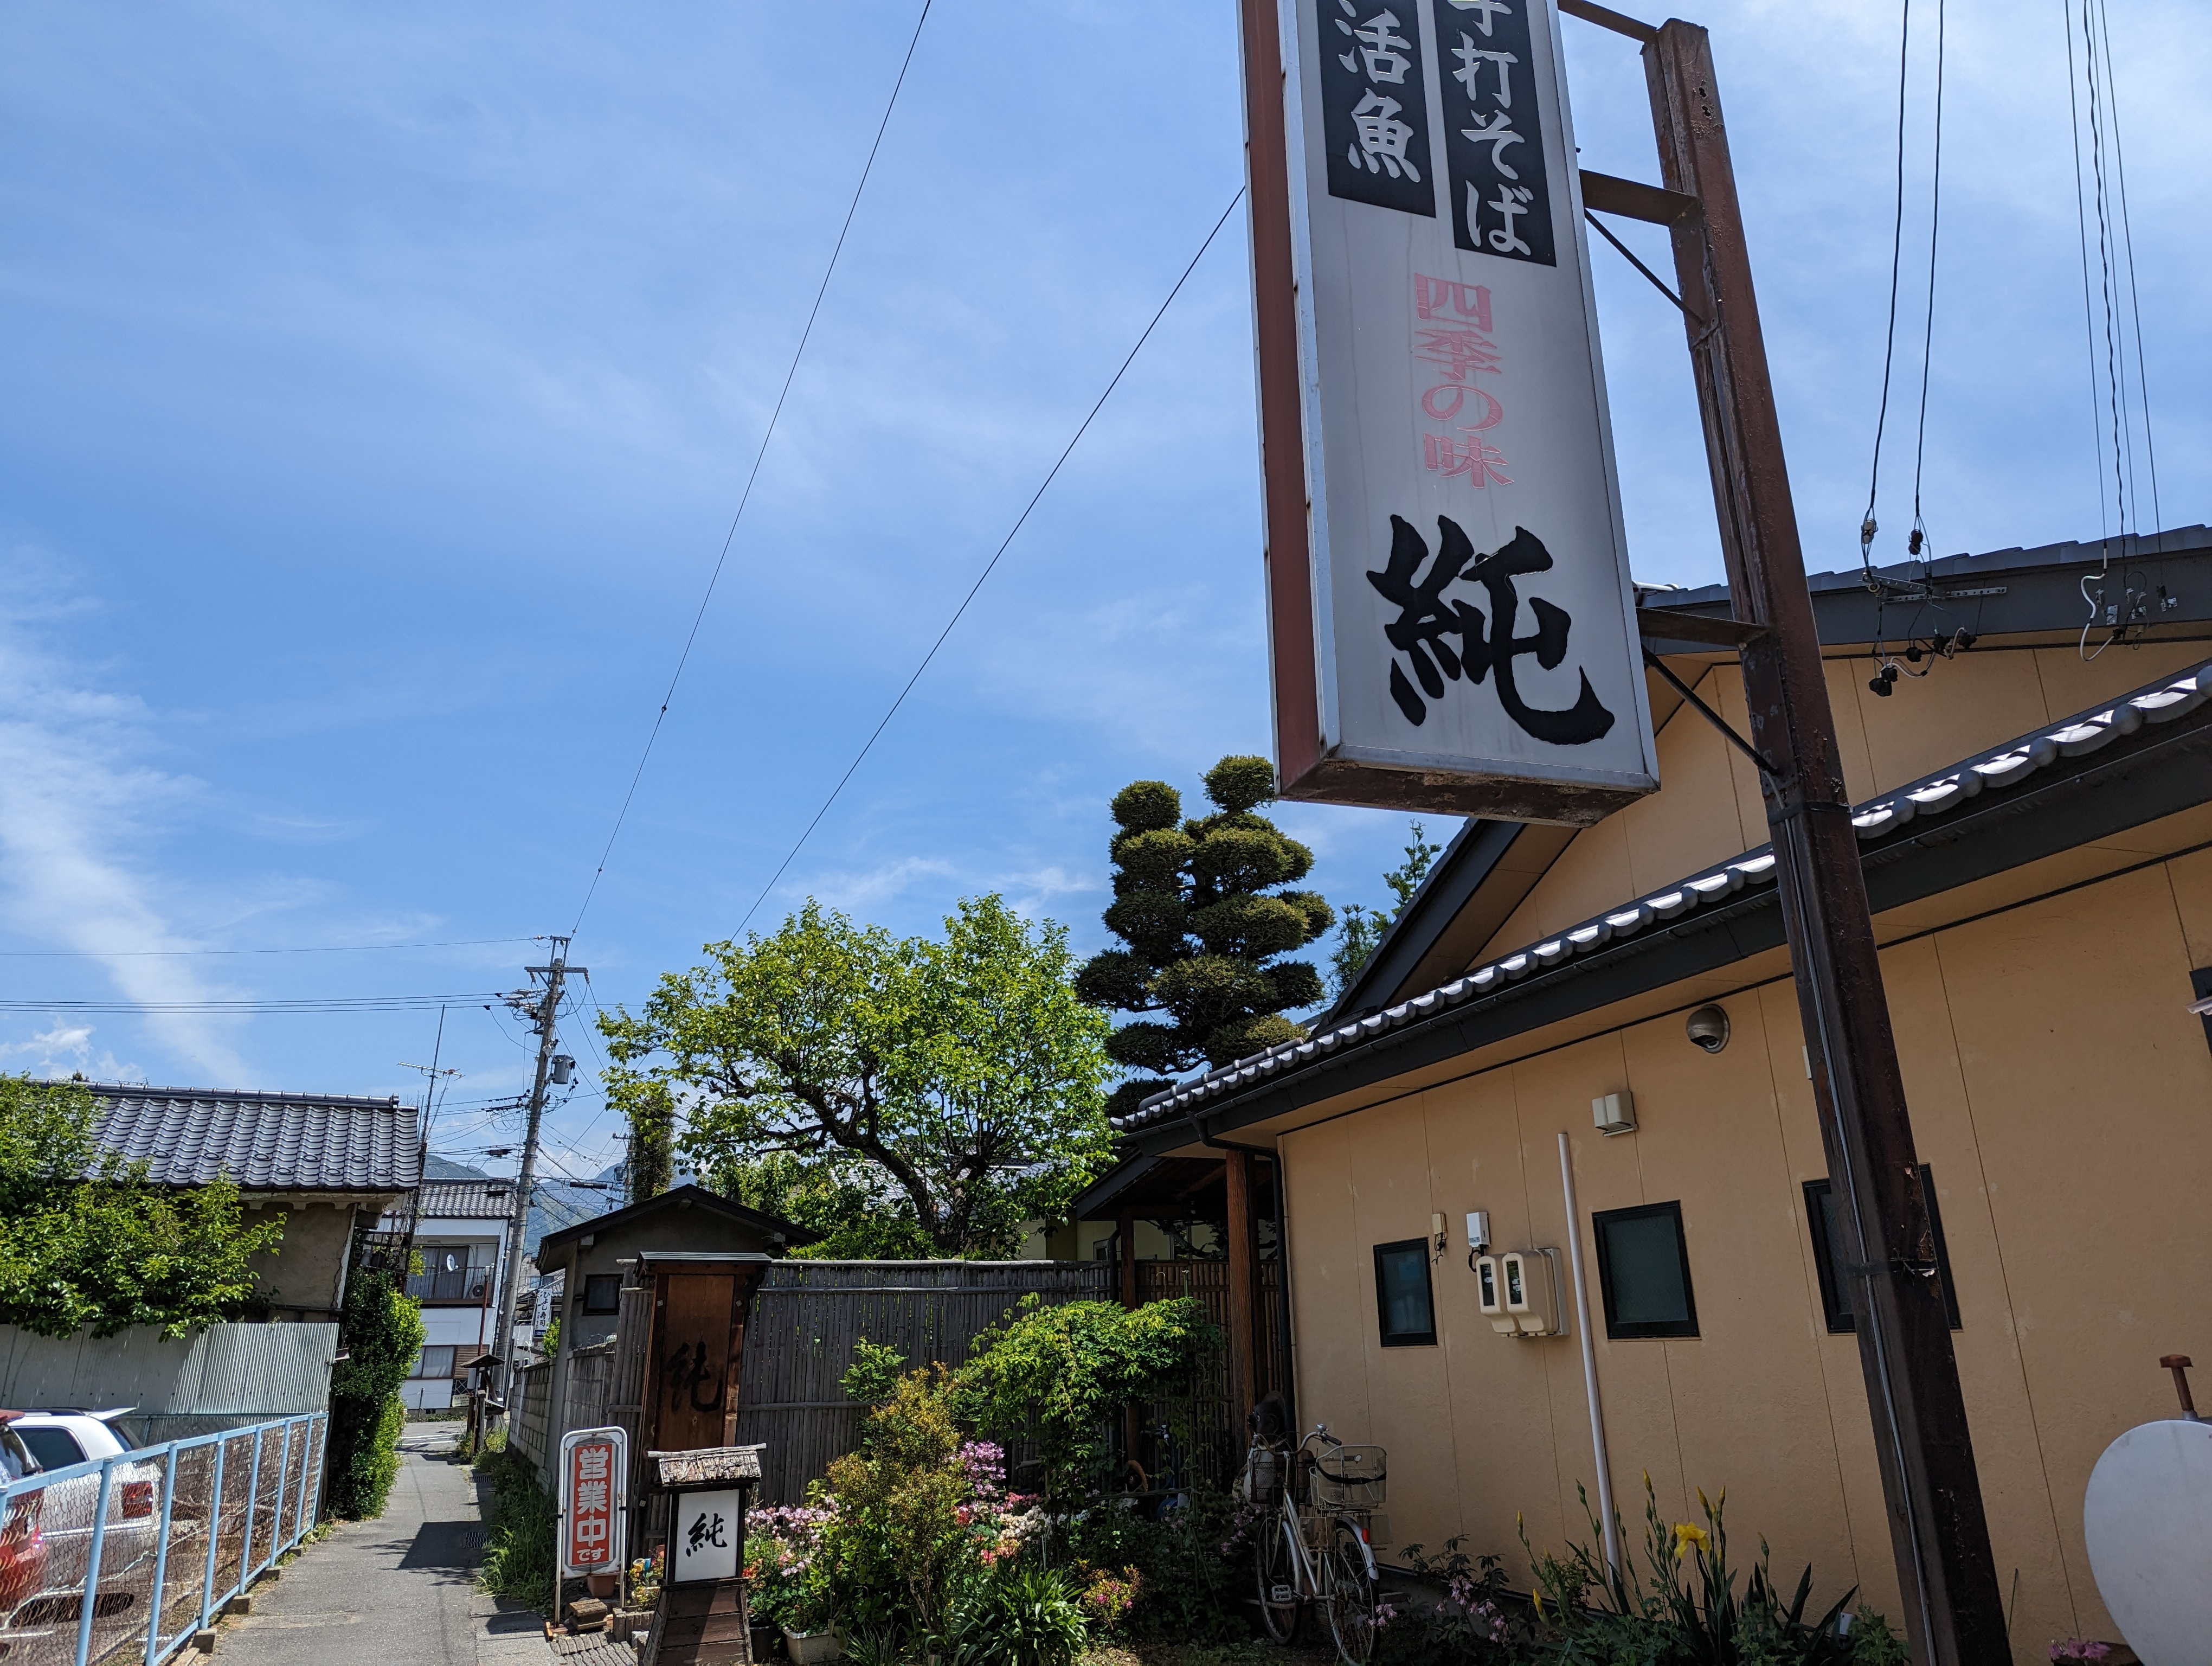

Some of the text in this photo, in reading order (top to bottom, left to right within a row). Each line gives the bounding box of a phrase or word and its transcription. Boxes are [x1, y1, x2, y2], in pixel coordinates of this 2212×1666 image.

[1335, 0, 1421, 183] 活魚
[1414, 273, 1515, 489] 四季の味
[1366, 514, 1615, 746] 純
[576, 1547, 606, 1561] です
[577, 1446, 609, 1547] 営業中
[686, 1513, 728, 1558] 純
